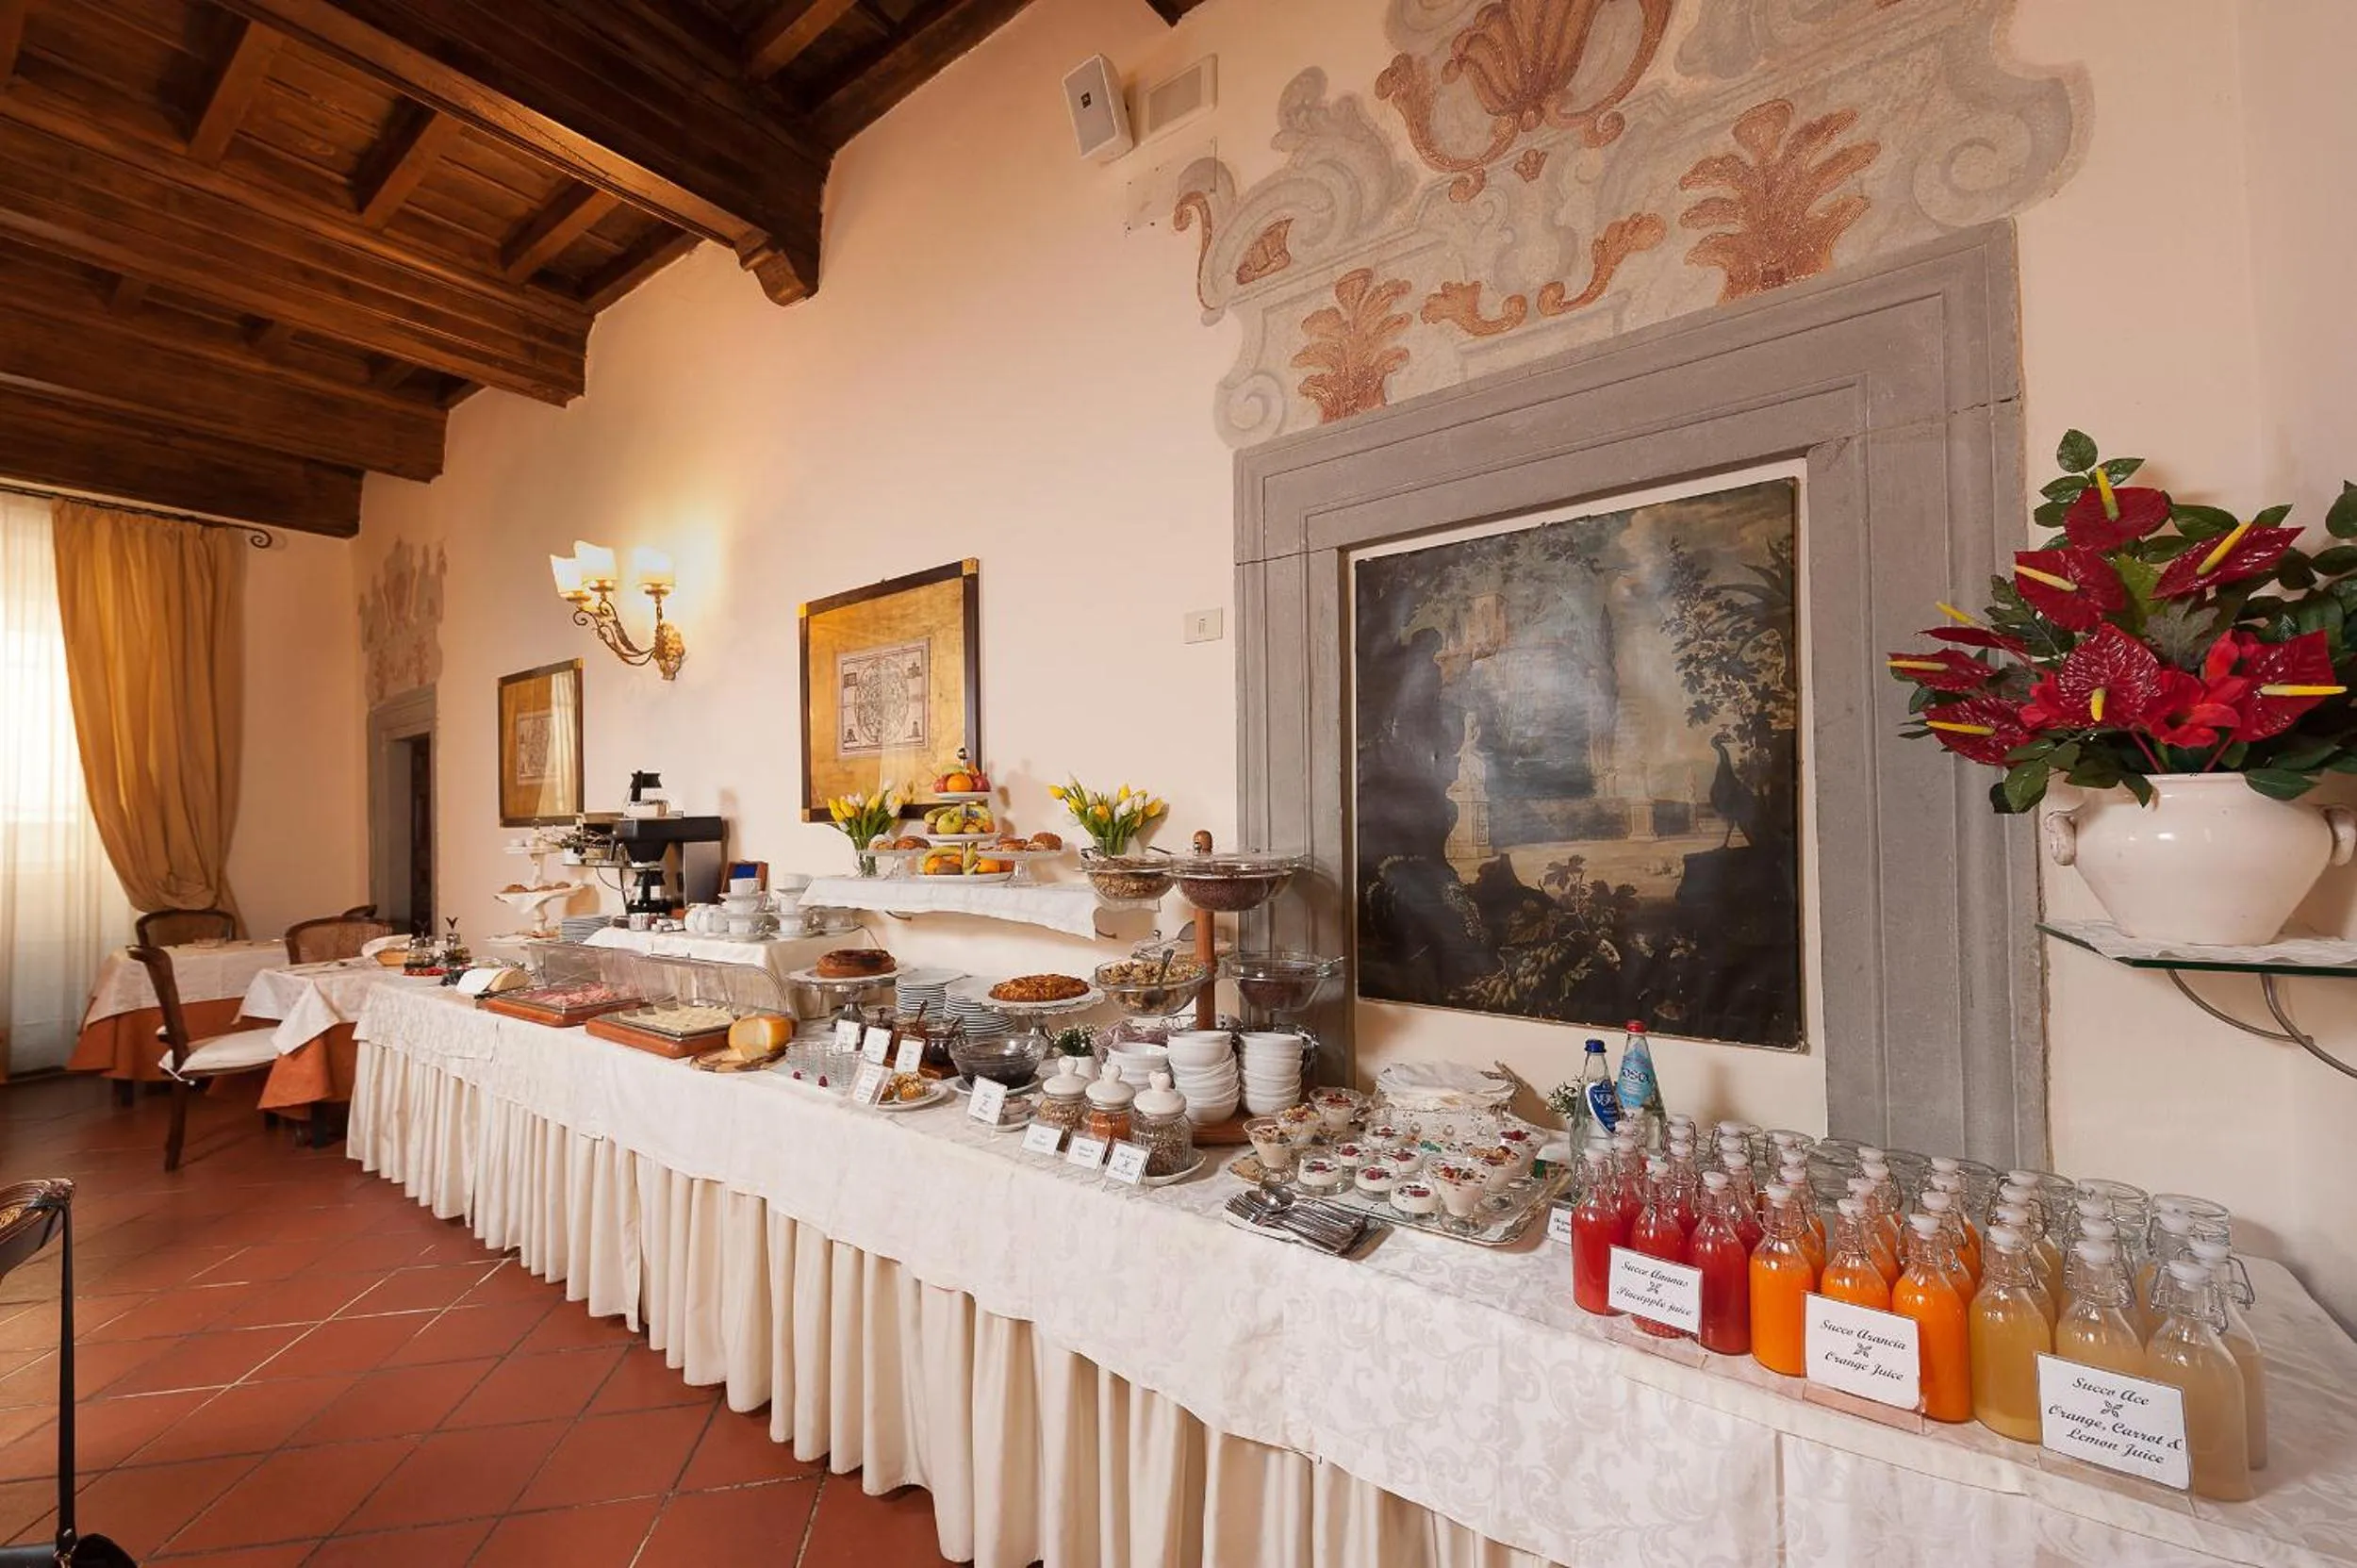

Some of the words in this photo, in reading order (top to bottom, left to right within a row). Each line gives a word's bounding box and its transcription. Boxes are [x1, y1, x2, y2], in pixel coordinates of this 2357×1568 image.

[1622, 1262, 1649, 1276] Succo
[1820, 1319, 1854, 1336] Succo
[1856, 1329, 1906, 1350] Arancia
[1824, 1350, 1869, 1371] Orange
[1871, 1363, 1904, 1381] Juice
[2072, 1377, 2116, 1396] Succo
[2120, 1390, 2150, 1406] Ace
[2048, 1403, 2107, 1431] Orange,
[2111, 1421, 2165, 1445] Carrot
[2167, 1438, 2184, 1450] &
[2066, 1428, 2119, 1451] Lemon
[2122, 1444, 2166, 1465] Juice
